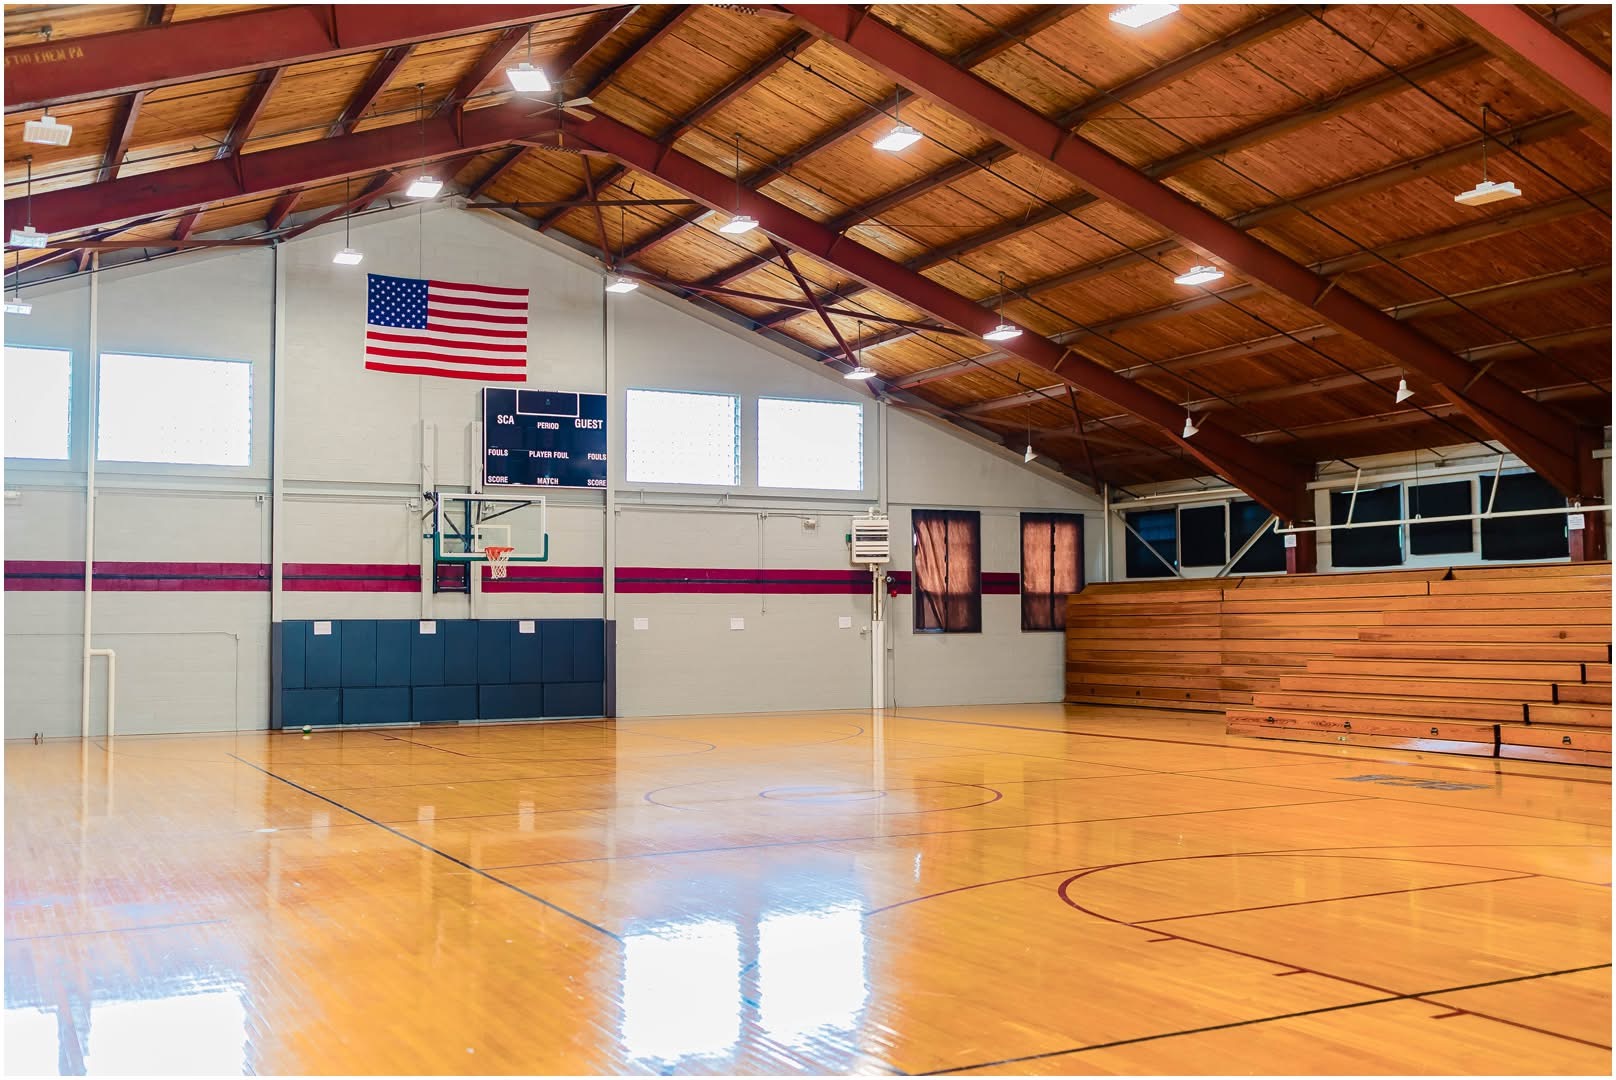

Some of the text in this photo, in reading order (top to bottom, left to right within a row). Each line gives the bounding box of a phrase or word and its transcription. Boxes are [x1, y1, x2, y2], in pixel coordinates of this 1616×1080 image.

[497, 414, 515, 425] SCA
[574, 418, 603, 429] GUEST
[537, 421, 559, 429] PERIOD
[488, 448, 509, 456] FOULS
[529, 450, 569, 459] PLAYER FOUL
[488, 475, 509, 483] SCORE
[537, 477, 559, 485] MATCH
[587, 479, 607, 487] SCORE
